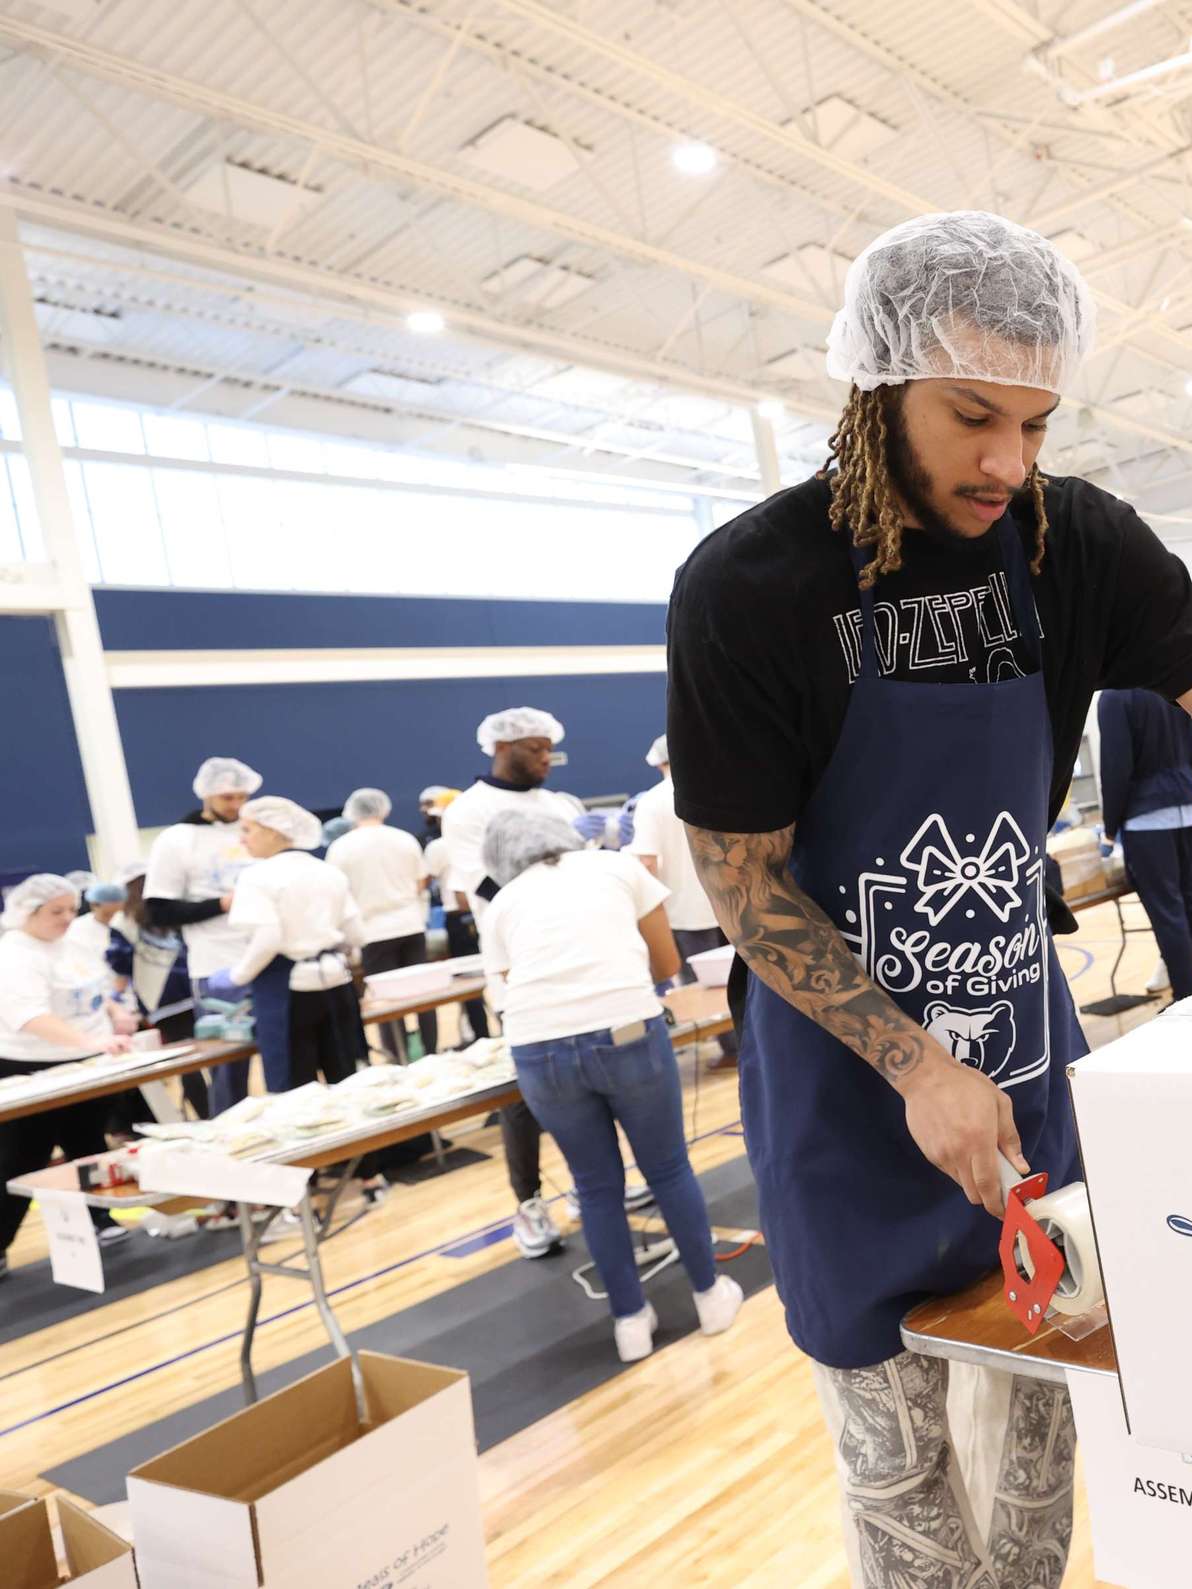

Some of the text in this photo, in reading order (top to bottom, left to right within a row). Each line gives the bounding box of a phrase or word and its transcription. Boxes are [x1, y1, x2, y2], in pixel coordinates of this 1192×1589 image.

[876, 922, 1040, 993] Season
[926, 962, 1040, 996] of Giving
